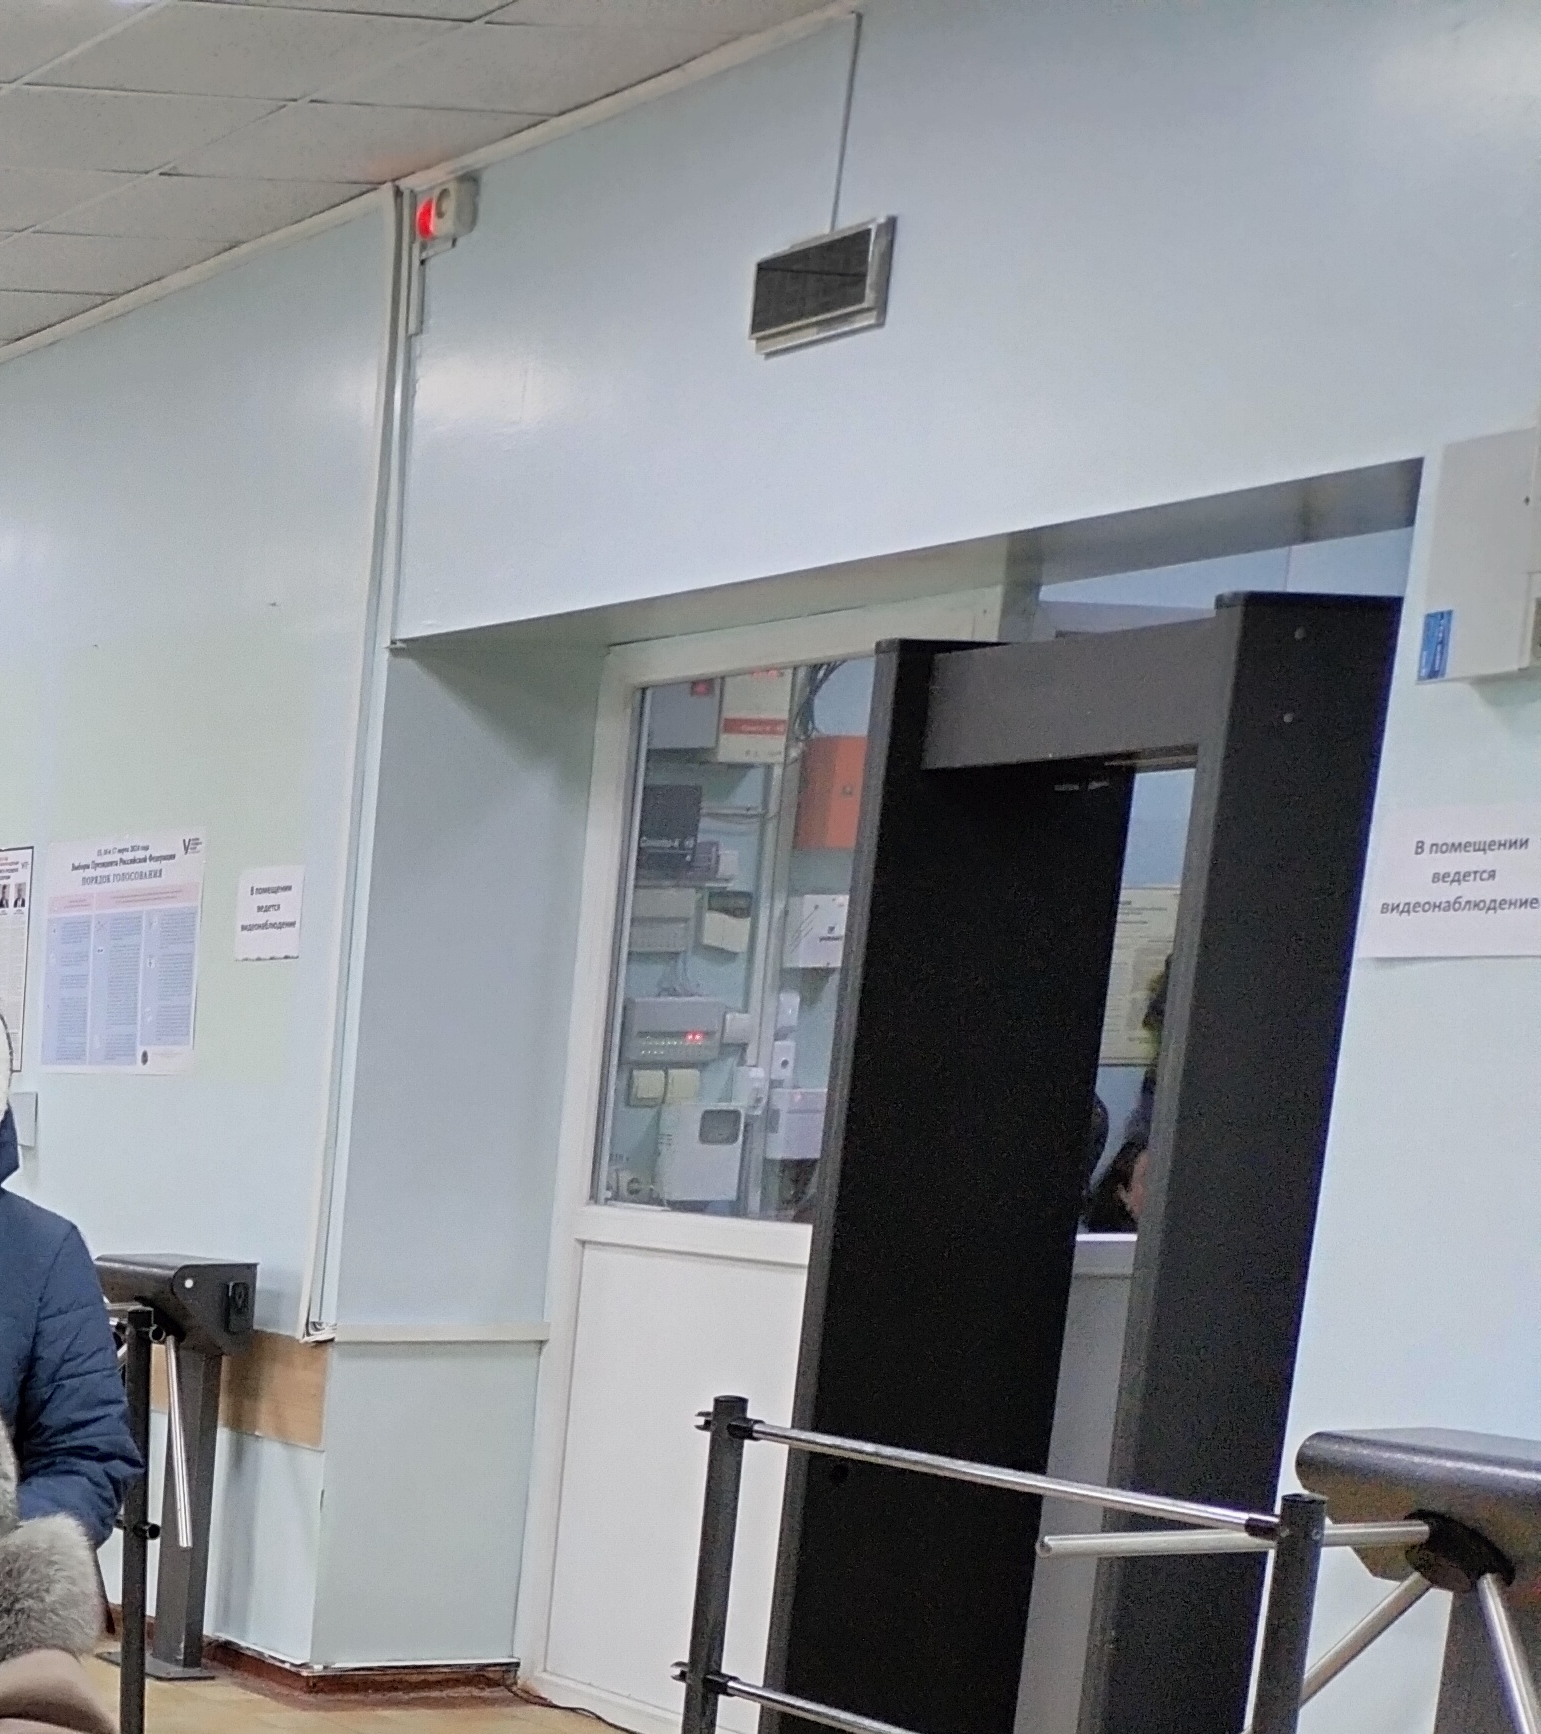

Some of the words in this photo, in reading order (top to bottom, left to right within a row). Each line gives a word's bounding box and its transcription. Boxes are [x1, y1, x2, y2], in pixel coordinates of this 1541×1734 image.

[1414, 840, 1425, 855] В
[1428, 837, 1530, 855] помещении
[81, 873, 111, 886] ПОРЯДОК
[112, 868, 163, 883] ГОЛОСОВАНИЯ
[1431, 869, 1497, 886] ведется
[1380, 895, 1540, 916] видеонаблюдение
